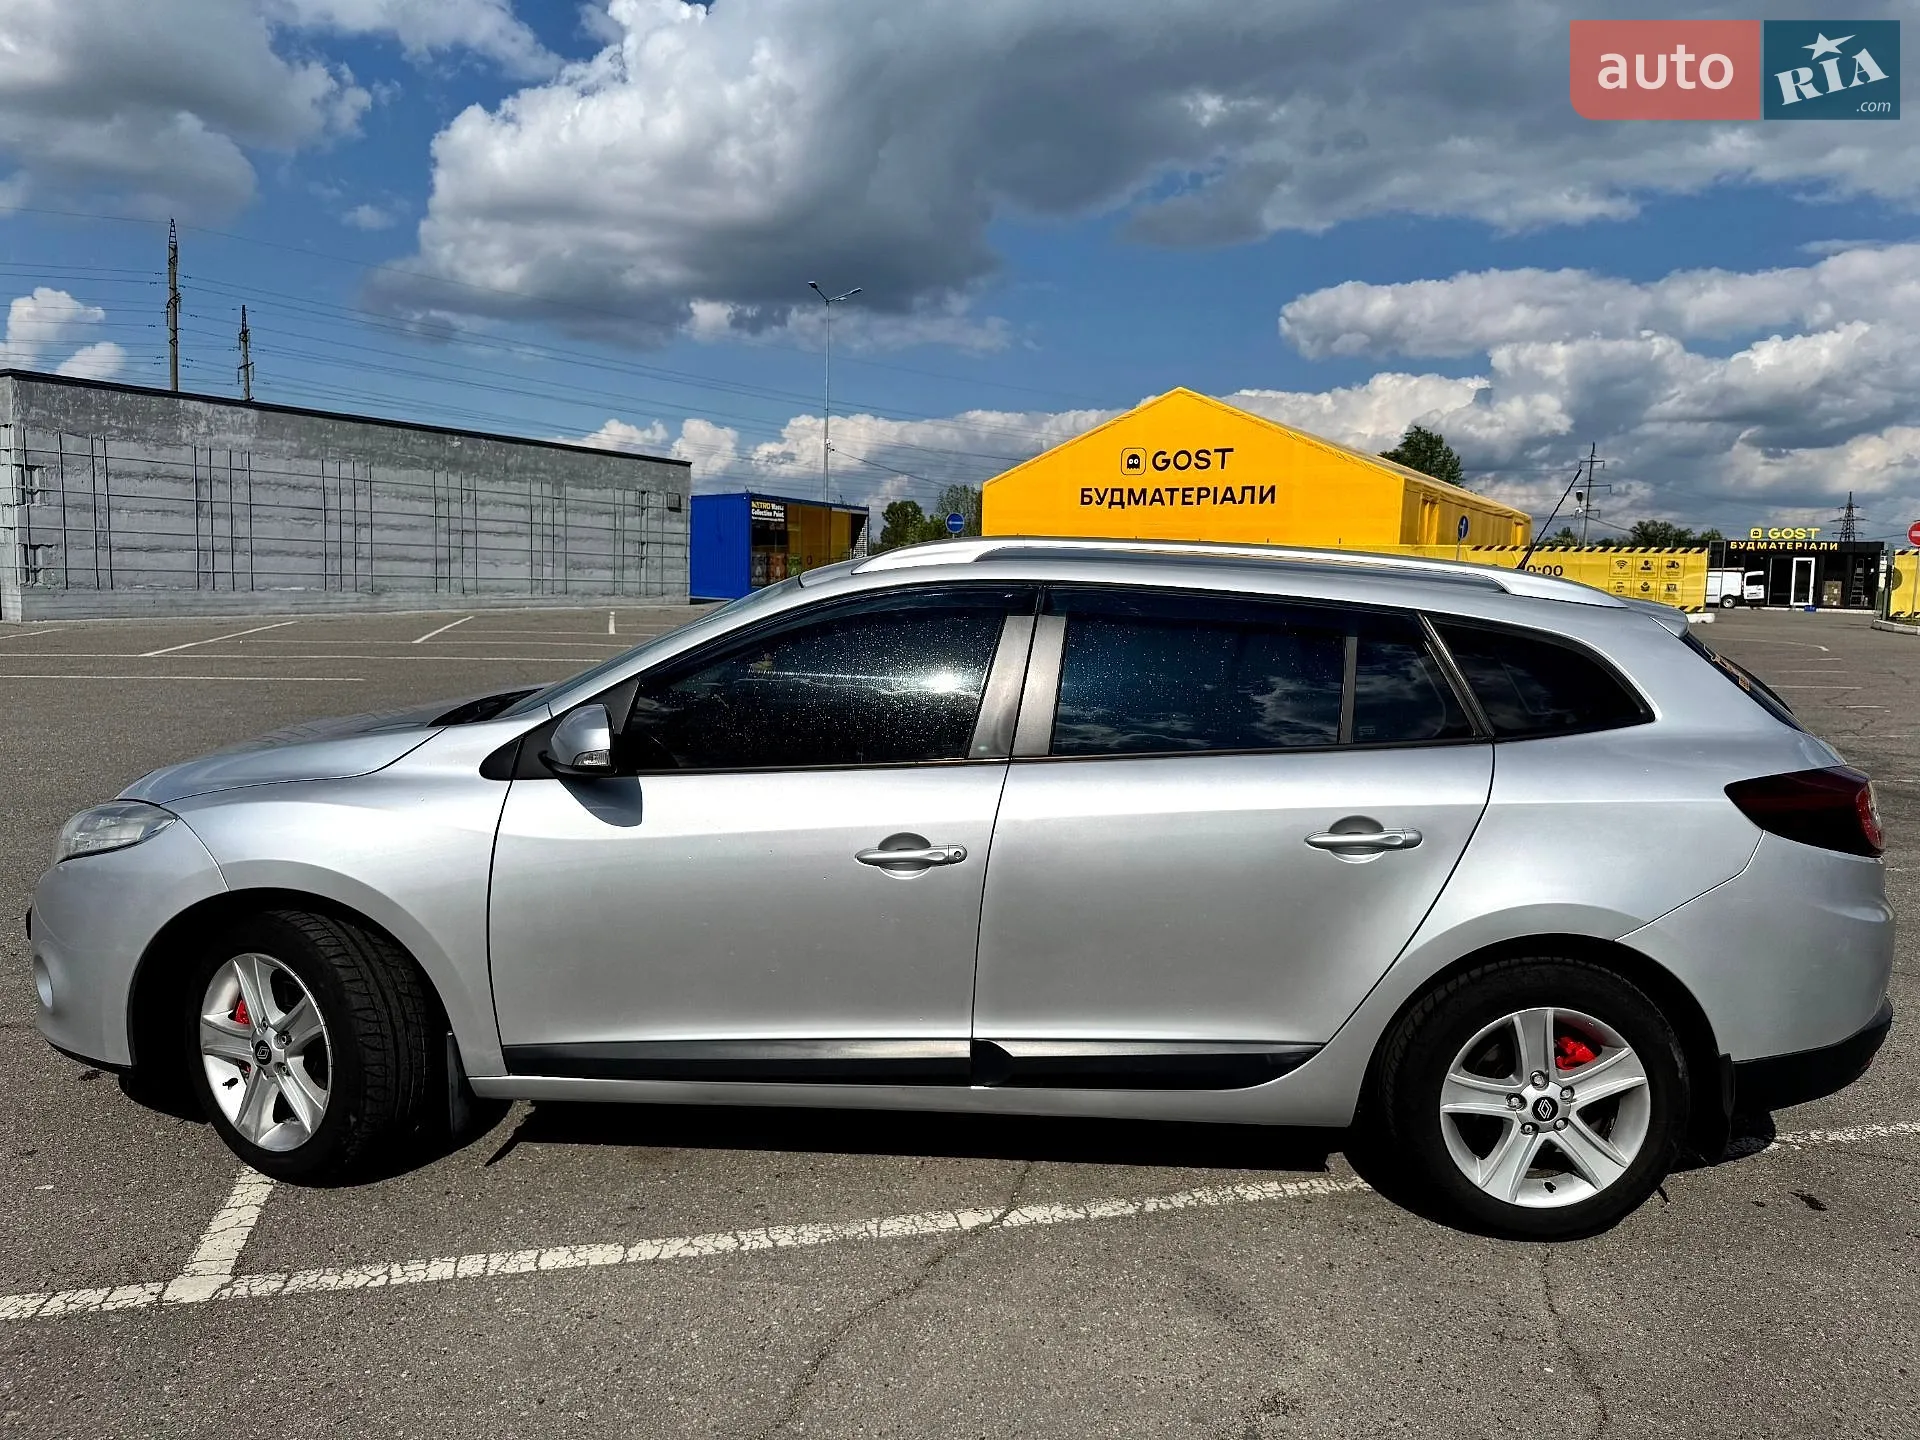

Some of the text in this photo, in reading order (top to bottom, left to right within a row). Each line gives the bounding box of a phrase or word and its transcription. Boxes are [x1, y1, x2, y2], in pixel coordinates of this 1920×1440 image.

[1152, 448, 1234, 471] GOST
[1080, 485, 1276, 509] БУДМАТЕРІАЛИ
[1768, 528, 1820, 539] GOST
[1730, 541, 1838, 551] БУДМАТЕРІАЛИ
